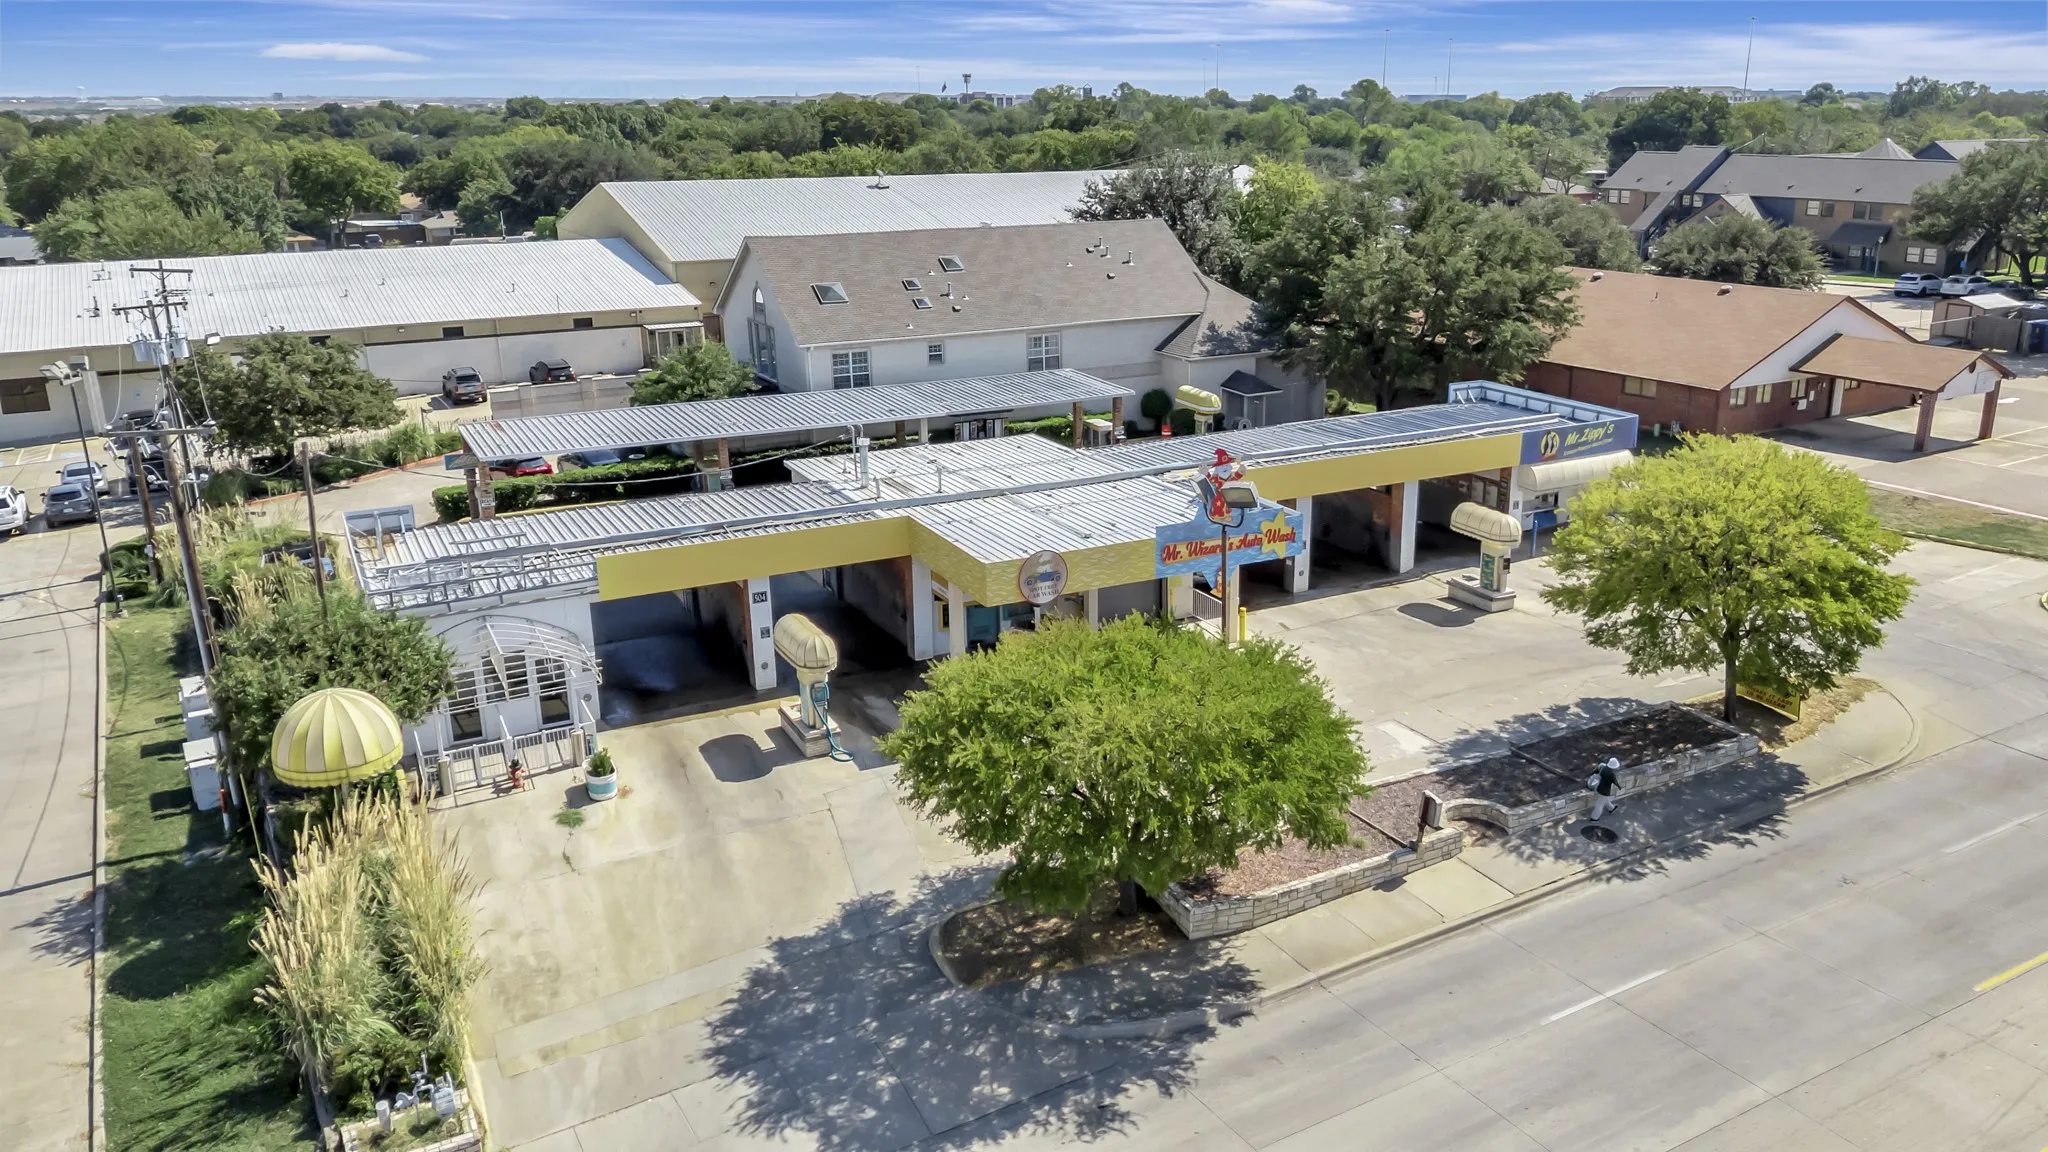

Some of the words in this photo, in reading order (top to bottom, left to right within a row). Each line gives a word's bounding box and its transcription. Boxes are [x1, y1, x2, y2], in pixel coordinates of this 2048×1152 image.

[1579, 422, 1615, 443] Zippy's
[1162, 543, 1183, 562] Mr.
[1186, 537, 1234, 557] Wizar's
[1236, 532, 1262, 549] Auto
[1265, 527, 1296, 544] Wash
[754, 593, 766, 601] 504
